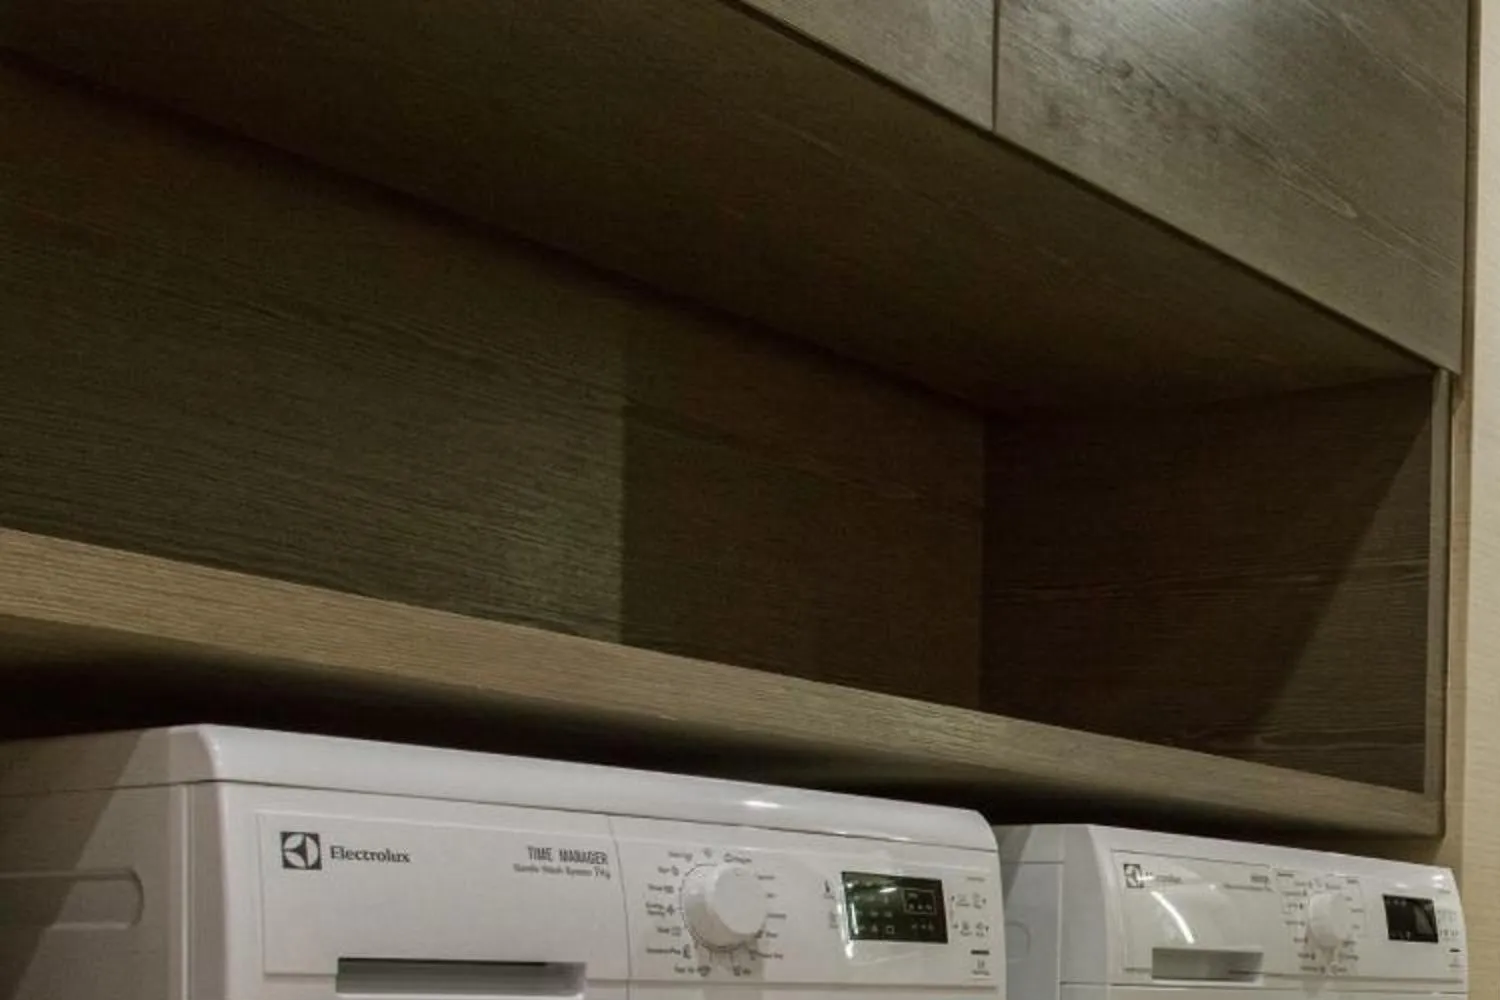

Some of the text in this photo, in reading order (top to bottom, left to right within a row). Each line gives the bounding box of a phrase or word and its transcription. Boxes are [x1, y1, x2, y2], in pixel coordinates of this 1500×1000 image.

[331, 845, 411, 862] Electrolux
[527, 845, 608, 864] TIME MANAGER
